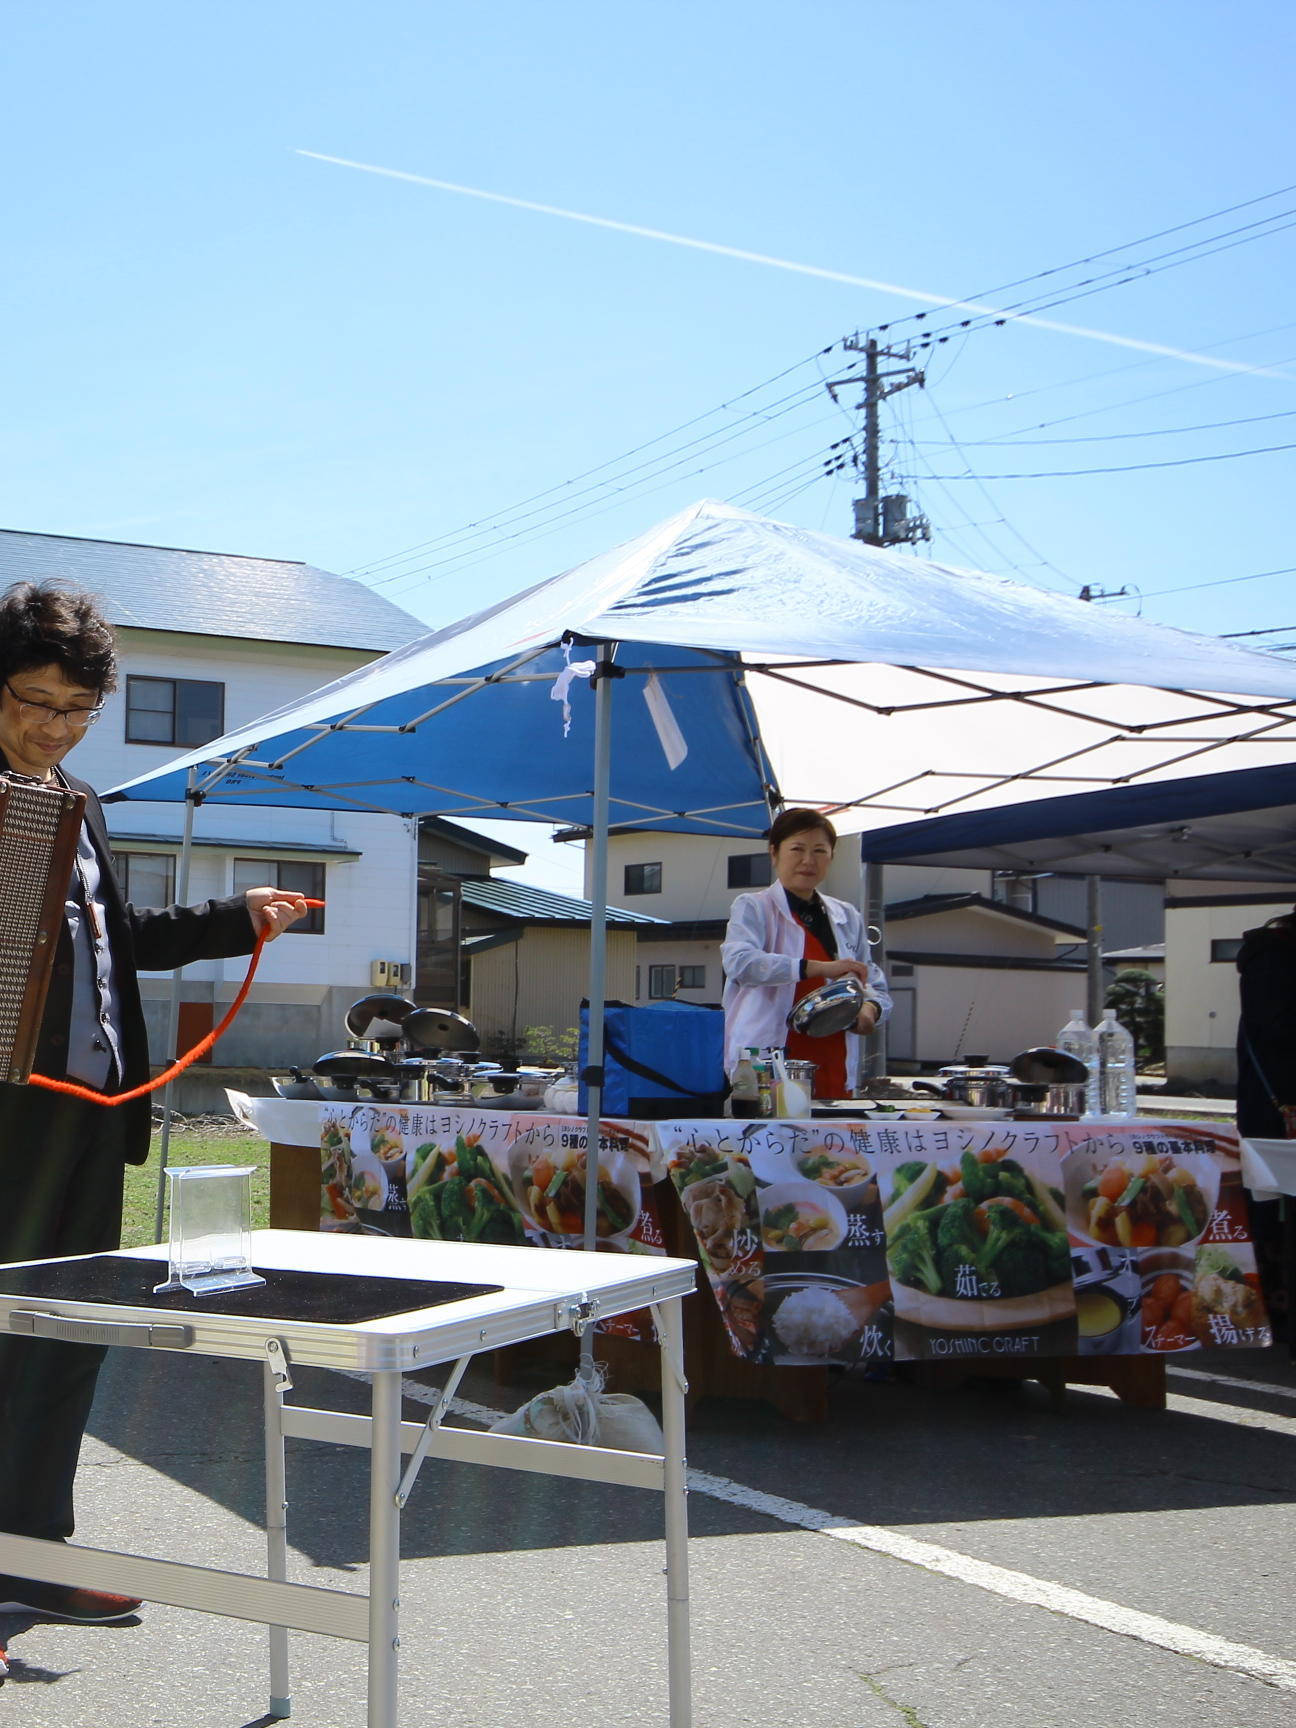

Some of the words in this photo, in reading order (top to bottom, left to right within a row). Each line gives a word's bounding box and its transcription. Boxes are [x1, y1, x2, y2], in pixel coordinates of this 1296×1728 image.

[847, 1213, 885, 1247] 蒸す
[1209, 1209, 1248, 1241] 煮る
[953, 1264, 1002, 1298] 茹でる
[859, 1324, 893, 1358] 炊く
[1144, 1325, 1197, 1349] スチーマー
